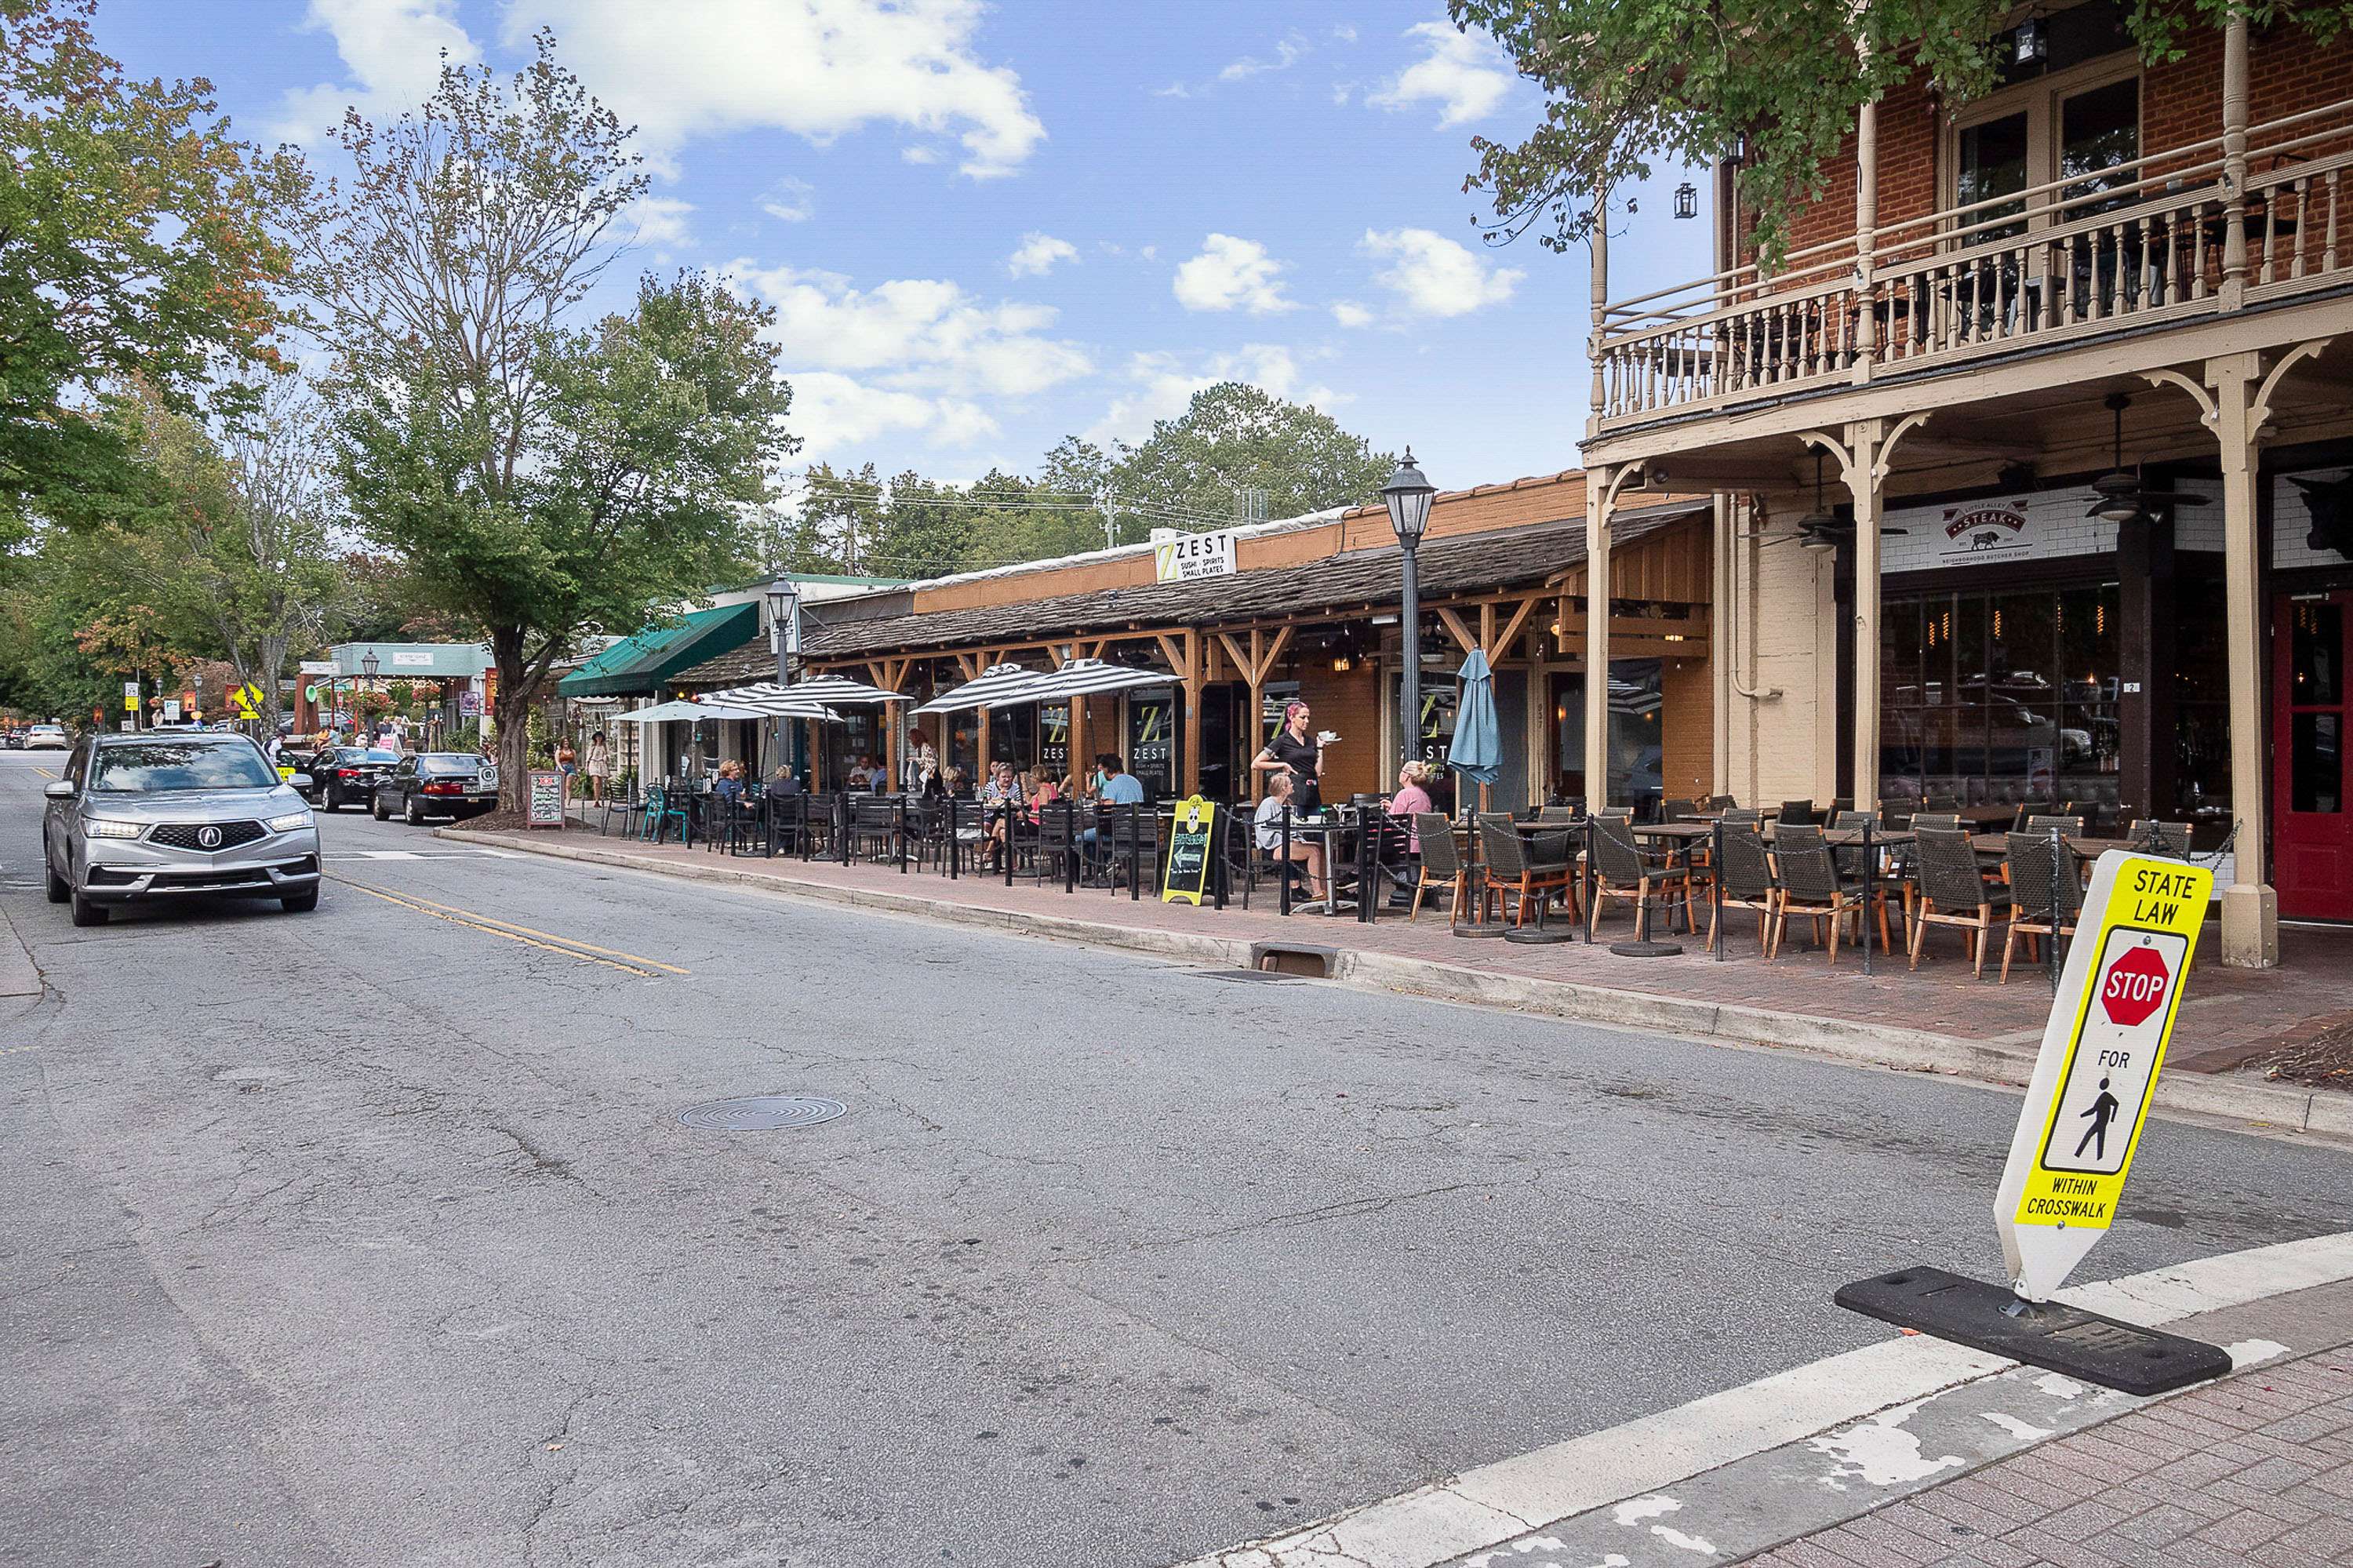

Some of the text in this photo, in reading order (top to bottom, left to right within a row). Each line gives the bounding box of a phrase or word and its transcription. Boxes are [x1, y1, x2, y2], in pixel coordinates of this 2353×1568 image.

[1964, 513, 2007, 527] STEAK
[1176, 534, 1227, 559] ZEST
[1180, 556, 1224, 570] SUSHI SPIRITS
[1183, 566, 1224, 578] SMALL PLATES
[1044, 748, 1068, 759] ZES
[1134, 748, 1166, 759] ZEST
[2133, 869, 2196, 899] STATE
[2133, 899, 2179, 926] LAW
[2106, 971, 2164, 1002] STOP
[2097, 1050, 2130, 1068] FOR
[2052, 1177, 2098, 1195] WITHIN
[2028, 1198, 2106, 1218] CROSSWALK
